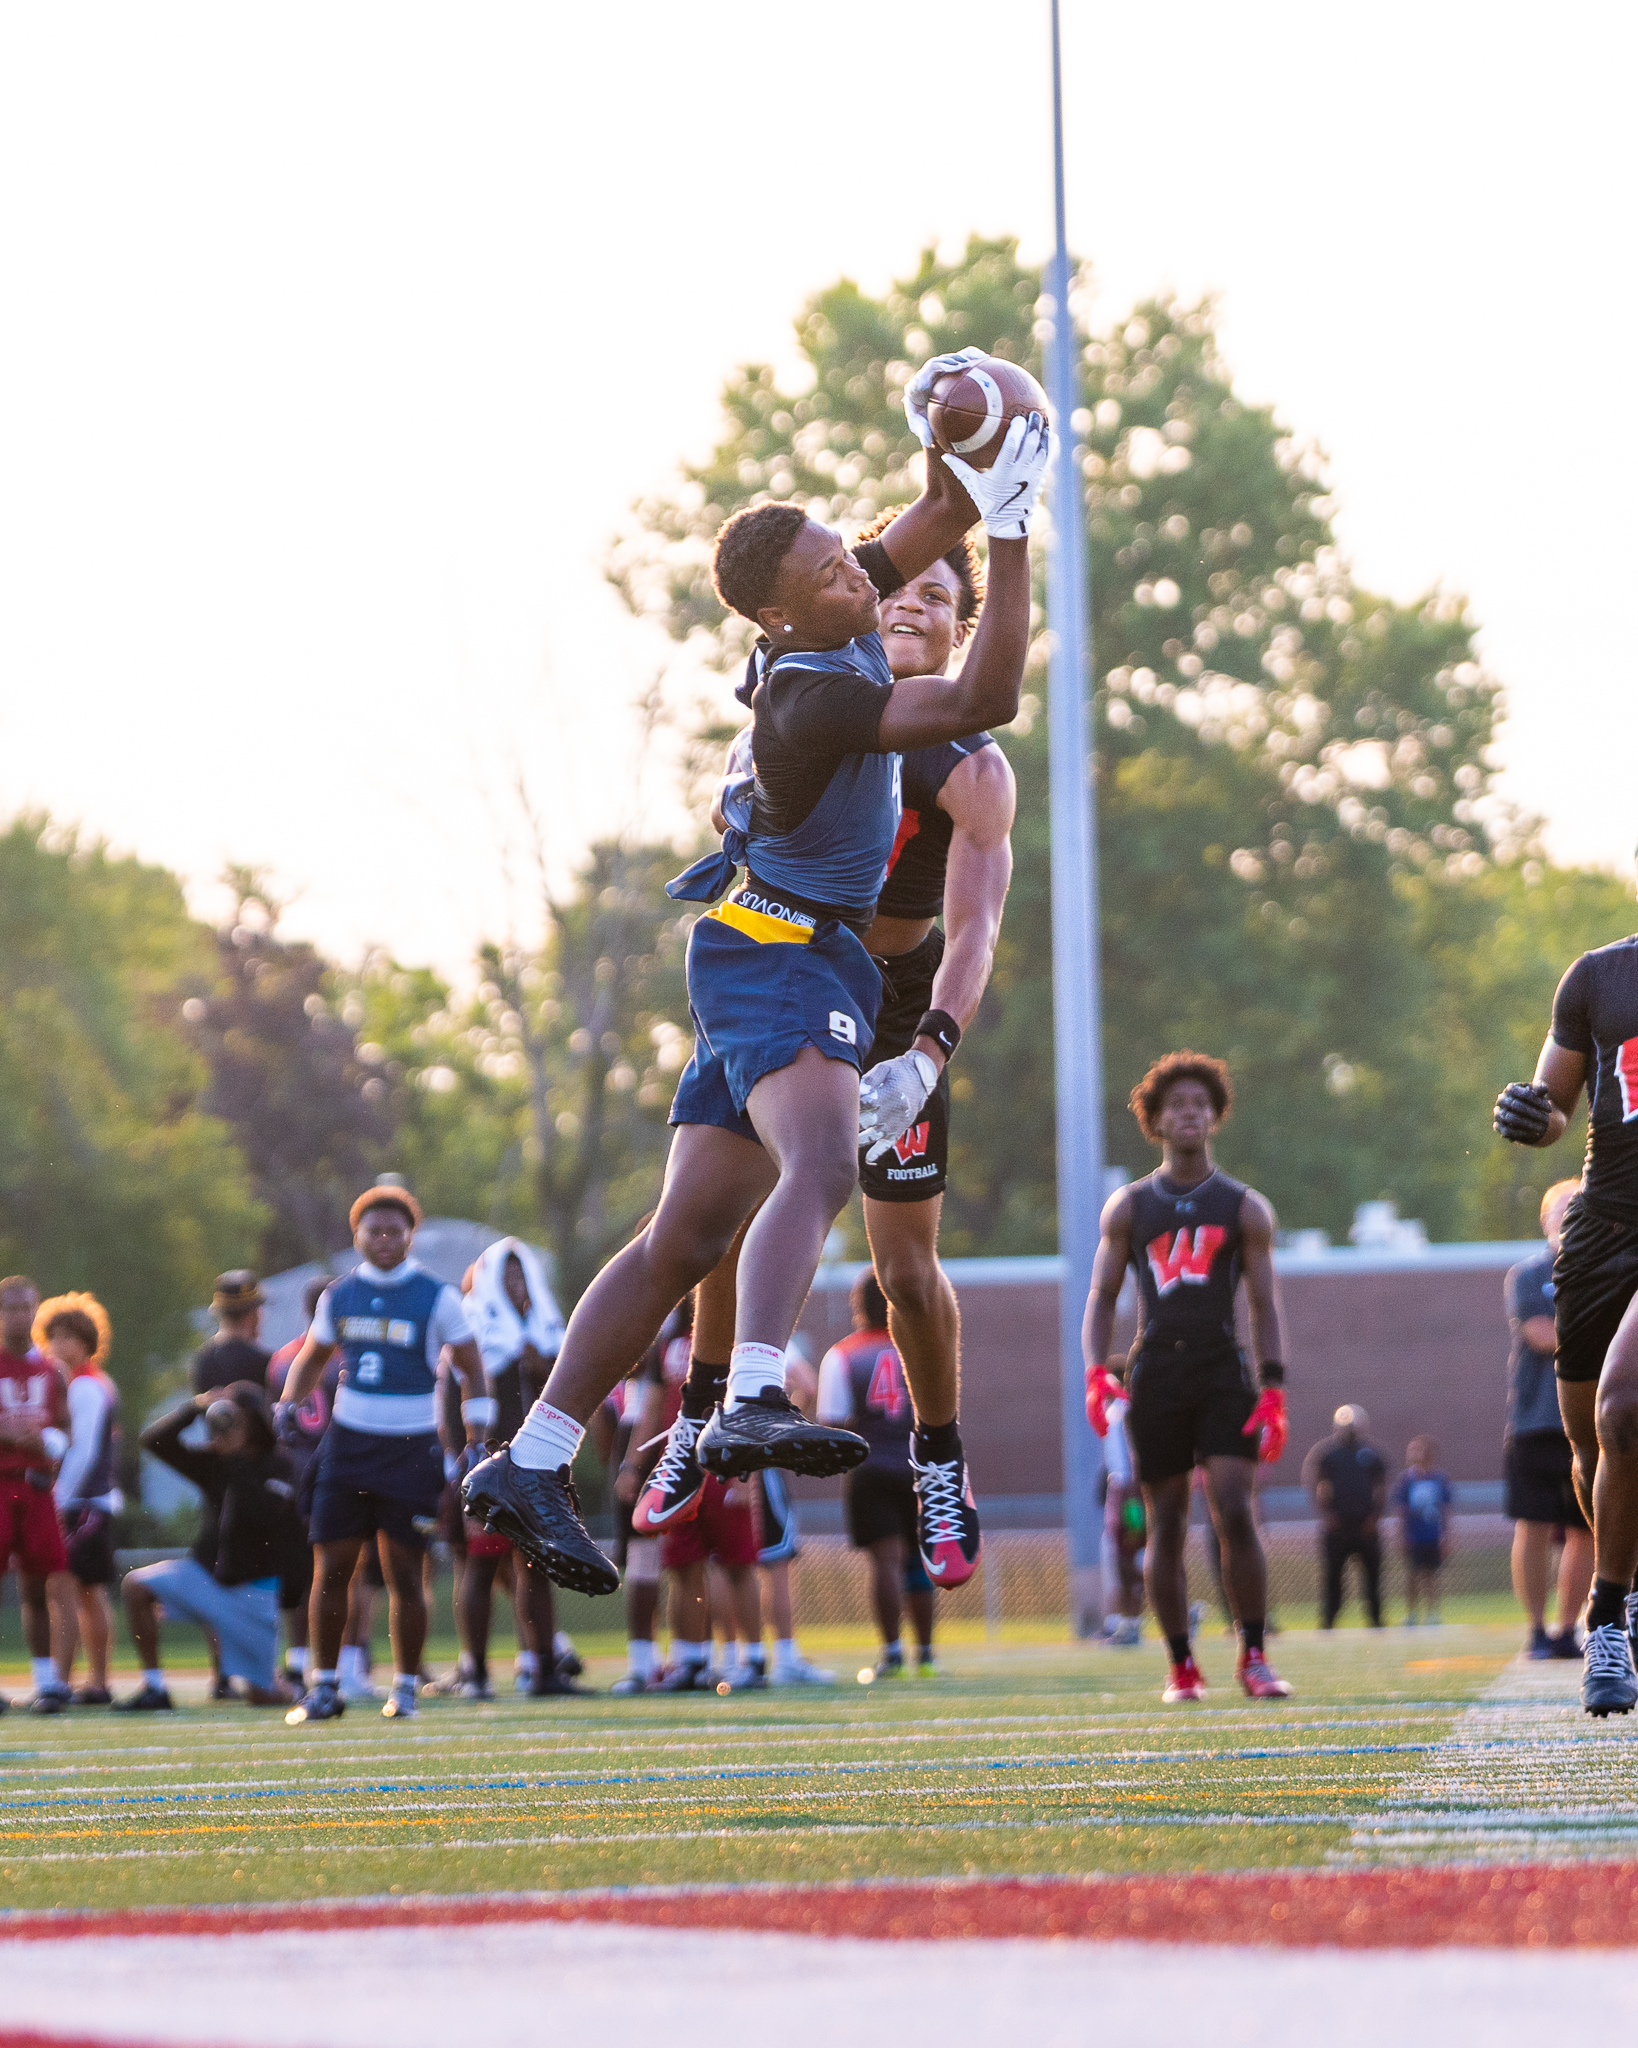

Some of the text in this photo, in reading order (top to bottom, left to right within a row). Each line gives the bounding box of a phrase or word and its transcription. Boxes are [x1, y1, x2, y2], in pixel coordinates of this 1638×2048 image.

[738, 890, 799, 924] NOVUS
[829, 1010, 857, 1045] 9
[892, 1120, 930, 1165] W
[887, 1163, 938, 1180] FOOTBALL
[1146, 1223, 1227, 1297] W
[357, 1351, 383, 1385] 2
[867, 1350, 907, 1419] 4
[536, 1403, 580, 1435] Supreme
